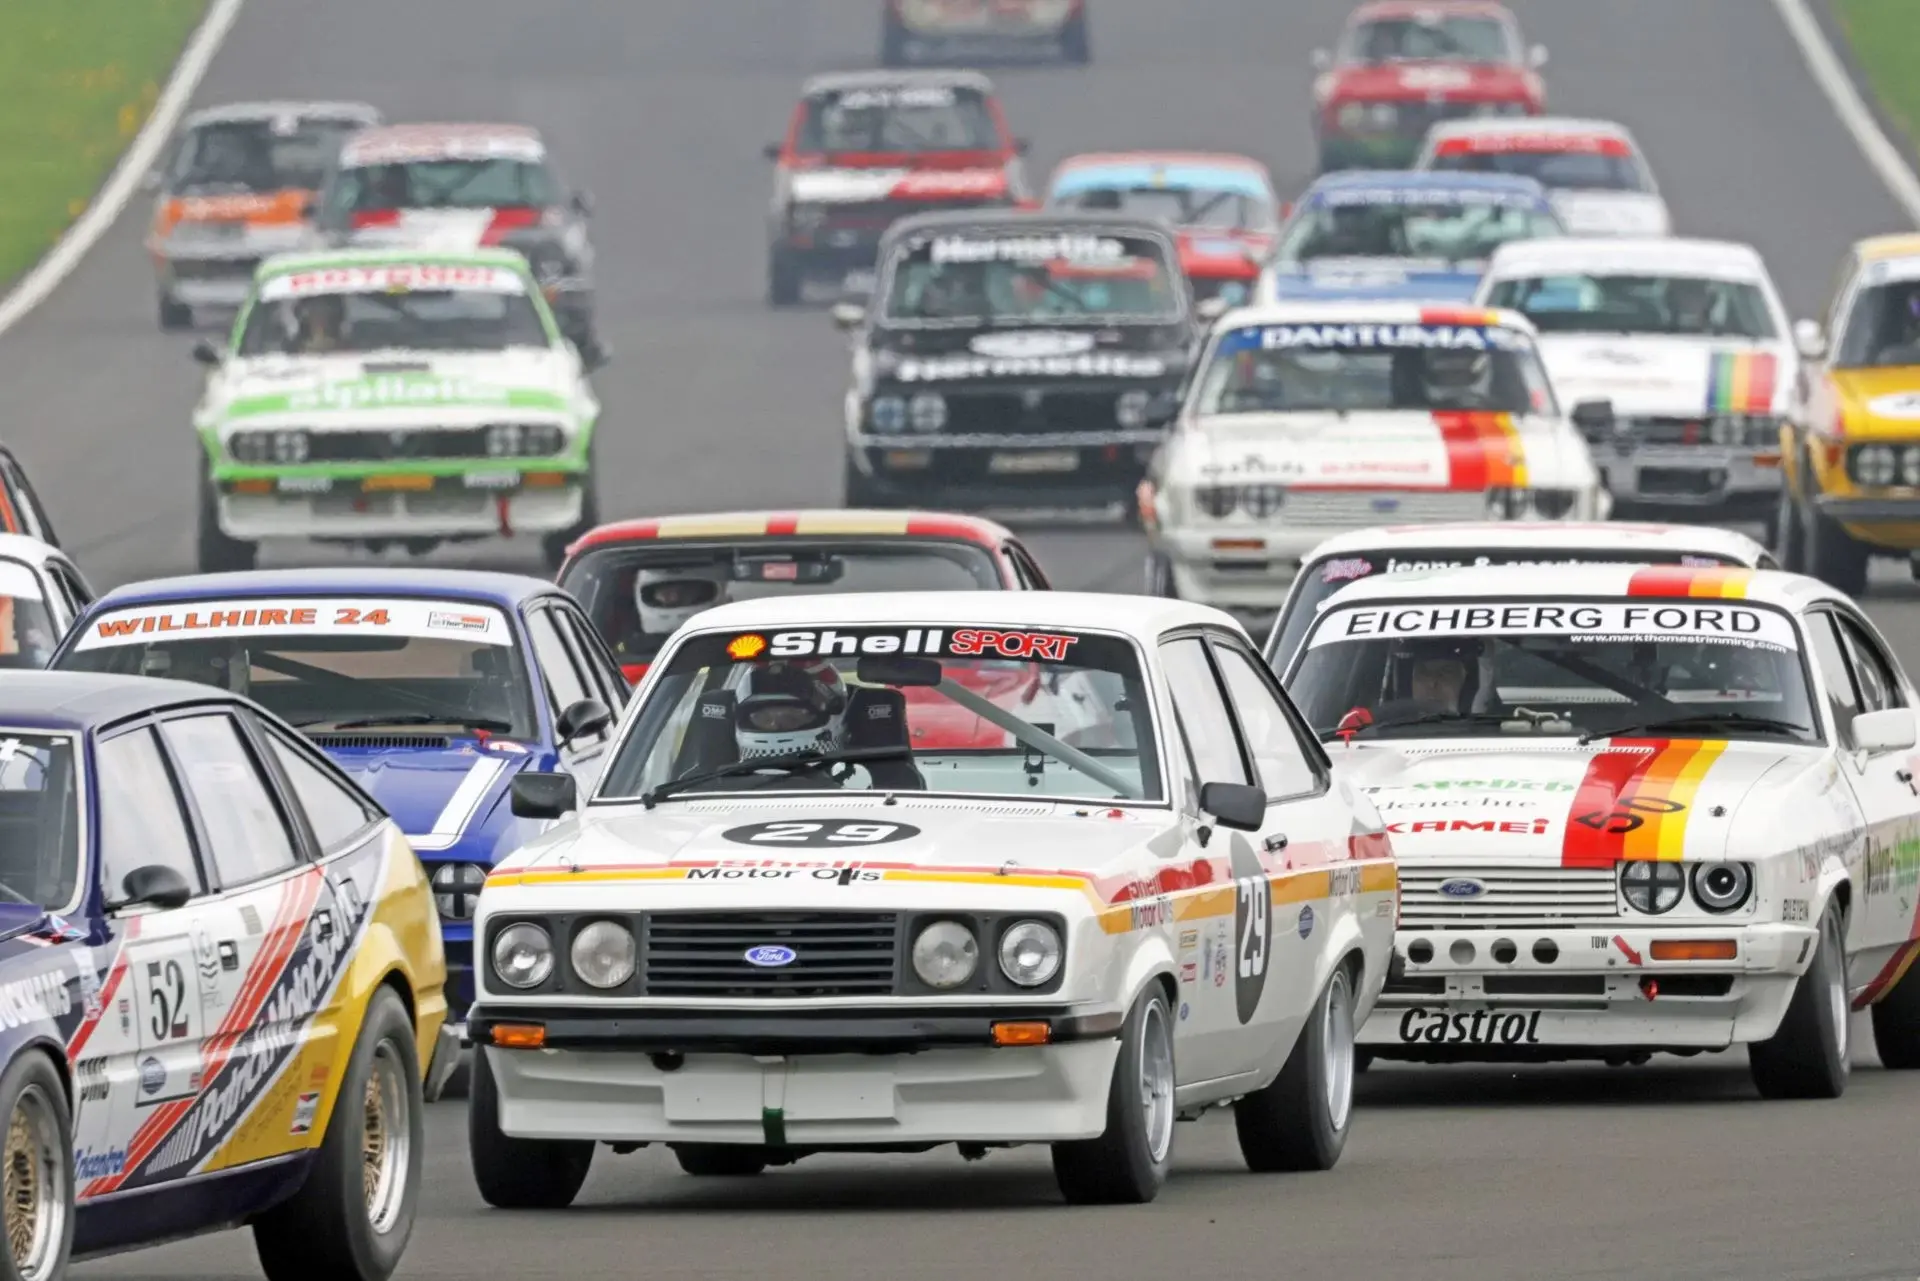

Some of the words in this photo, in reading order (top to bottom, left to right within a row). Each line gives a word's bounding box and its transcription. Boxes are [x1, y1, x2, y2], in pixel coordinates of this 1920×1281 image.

[1261, 326, 1487, 349] DANTUMA
[97, 609, 319, 638] WILLHIRE
[333, 607, 392, 626] 24
[1346, 607, 1602, 636] EICHBERG
[1624, 607, 1761, 634] FORD
[770, 629, 943, 656] Shell
[949, 629, 1079, 661] SPORT
[1570, 632, 1787, 654] www.markthomastrimming.com
[750, 823, 899, 842] 29
[686, 868, 801, 879] Motor
[1238, 875, 1267, 979] 29
[756, 948, 785, 962] Ford
[1591, 936, 1609, 949] TOW
[147, 959, 189, 1041] 52
[1400, 1007, 1542, 1044] Castrol
